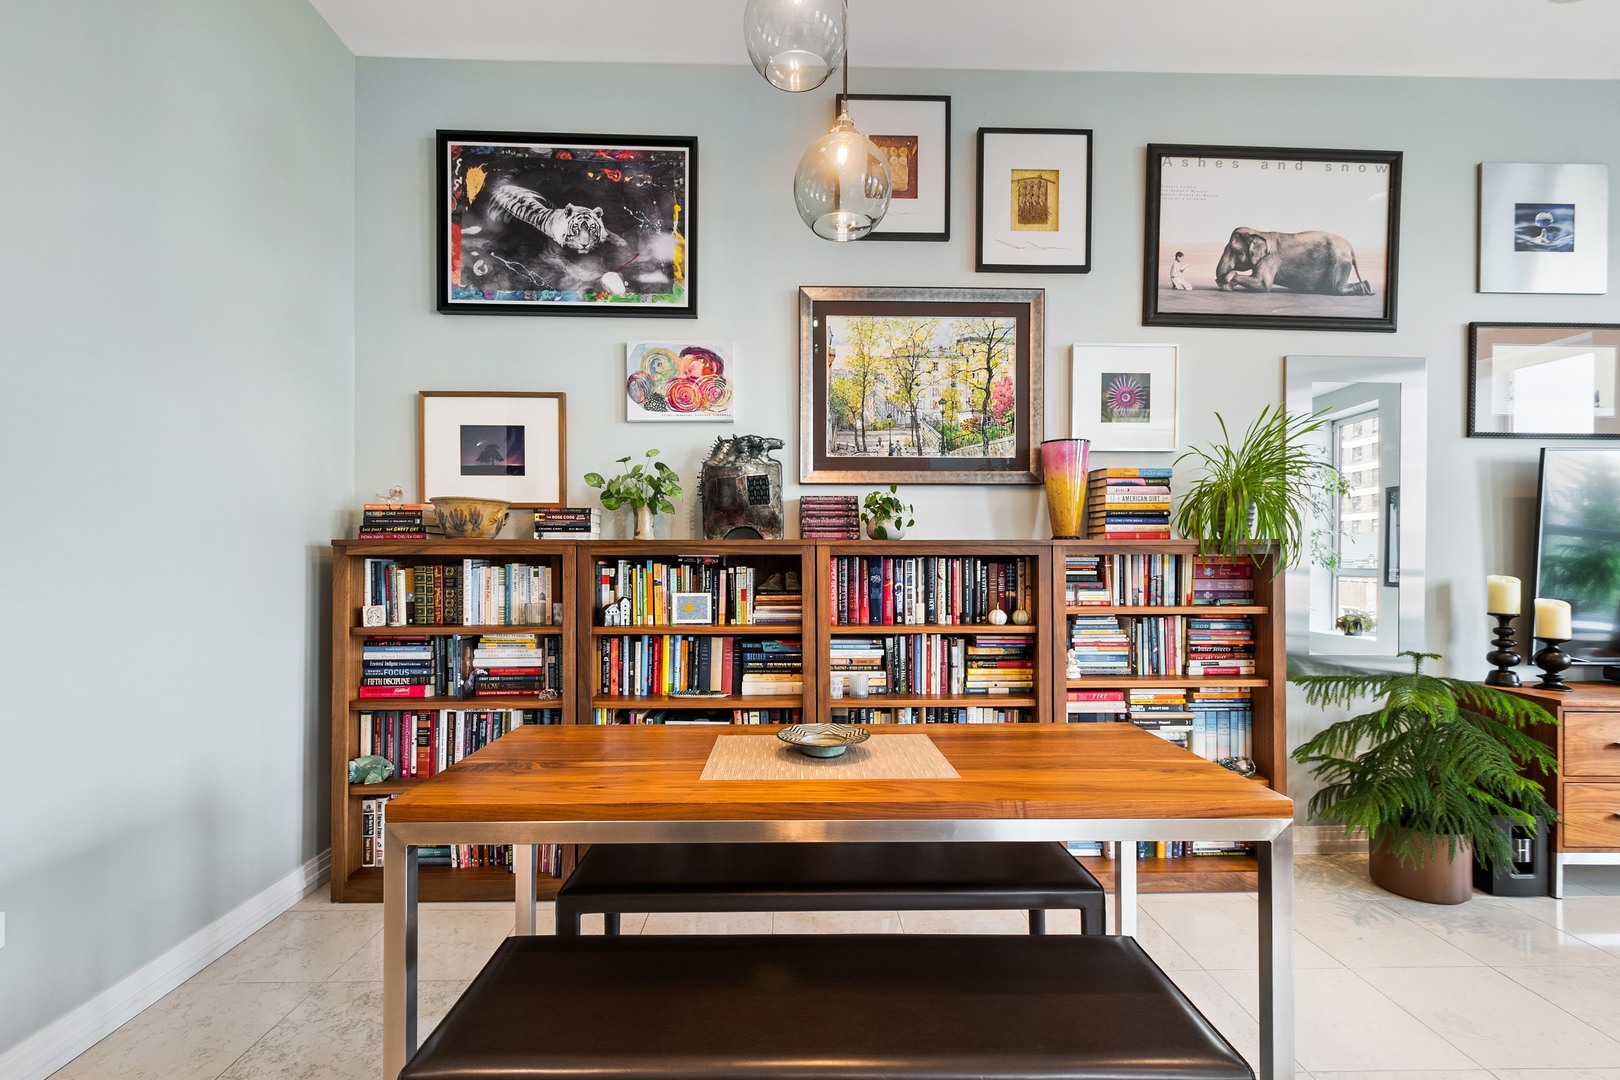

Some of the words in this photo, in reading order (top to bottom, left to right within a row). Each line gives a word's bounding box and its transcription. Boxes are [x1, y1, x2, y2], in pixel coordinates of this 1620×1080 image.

[1162, 156, 1240, 169] Ashes
[1261, 159, 1304, 171] and
[1325, 162, 1389, 174] snow
[383, 668, 410, 676] FOCUS
[367, 677, 382, 686] FIFTH
[383, 677, 410, 686] DISCIPLINE
